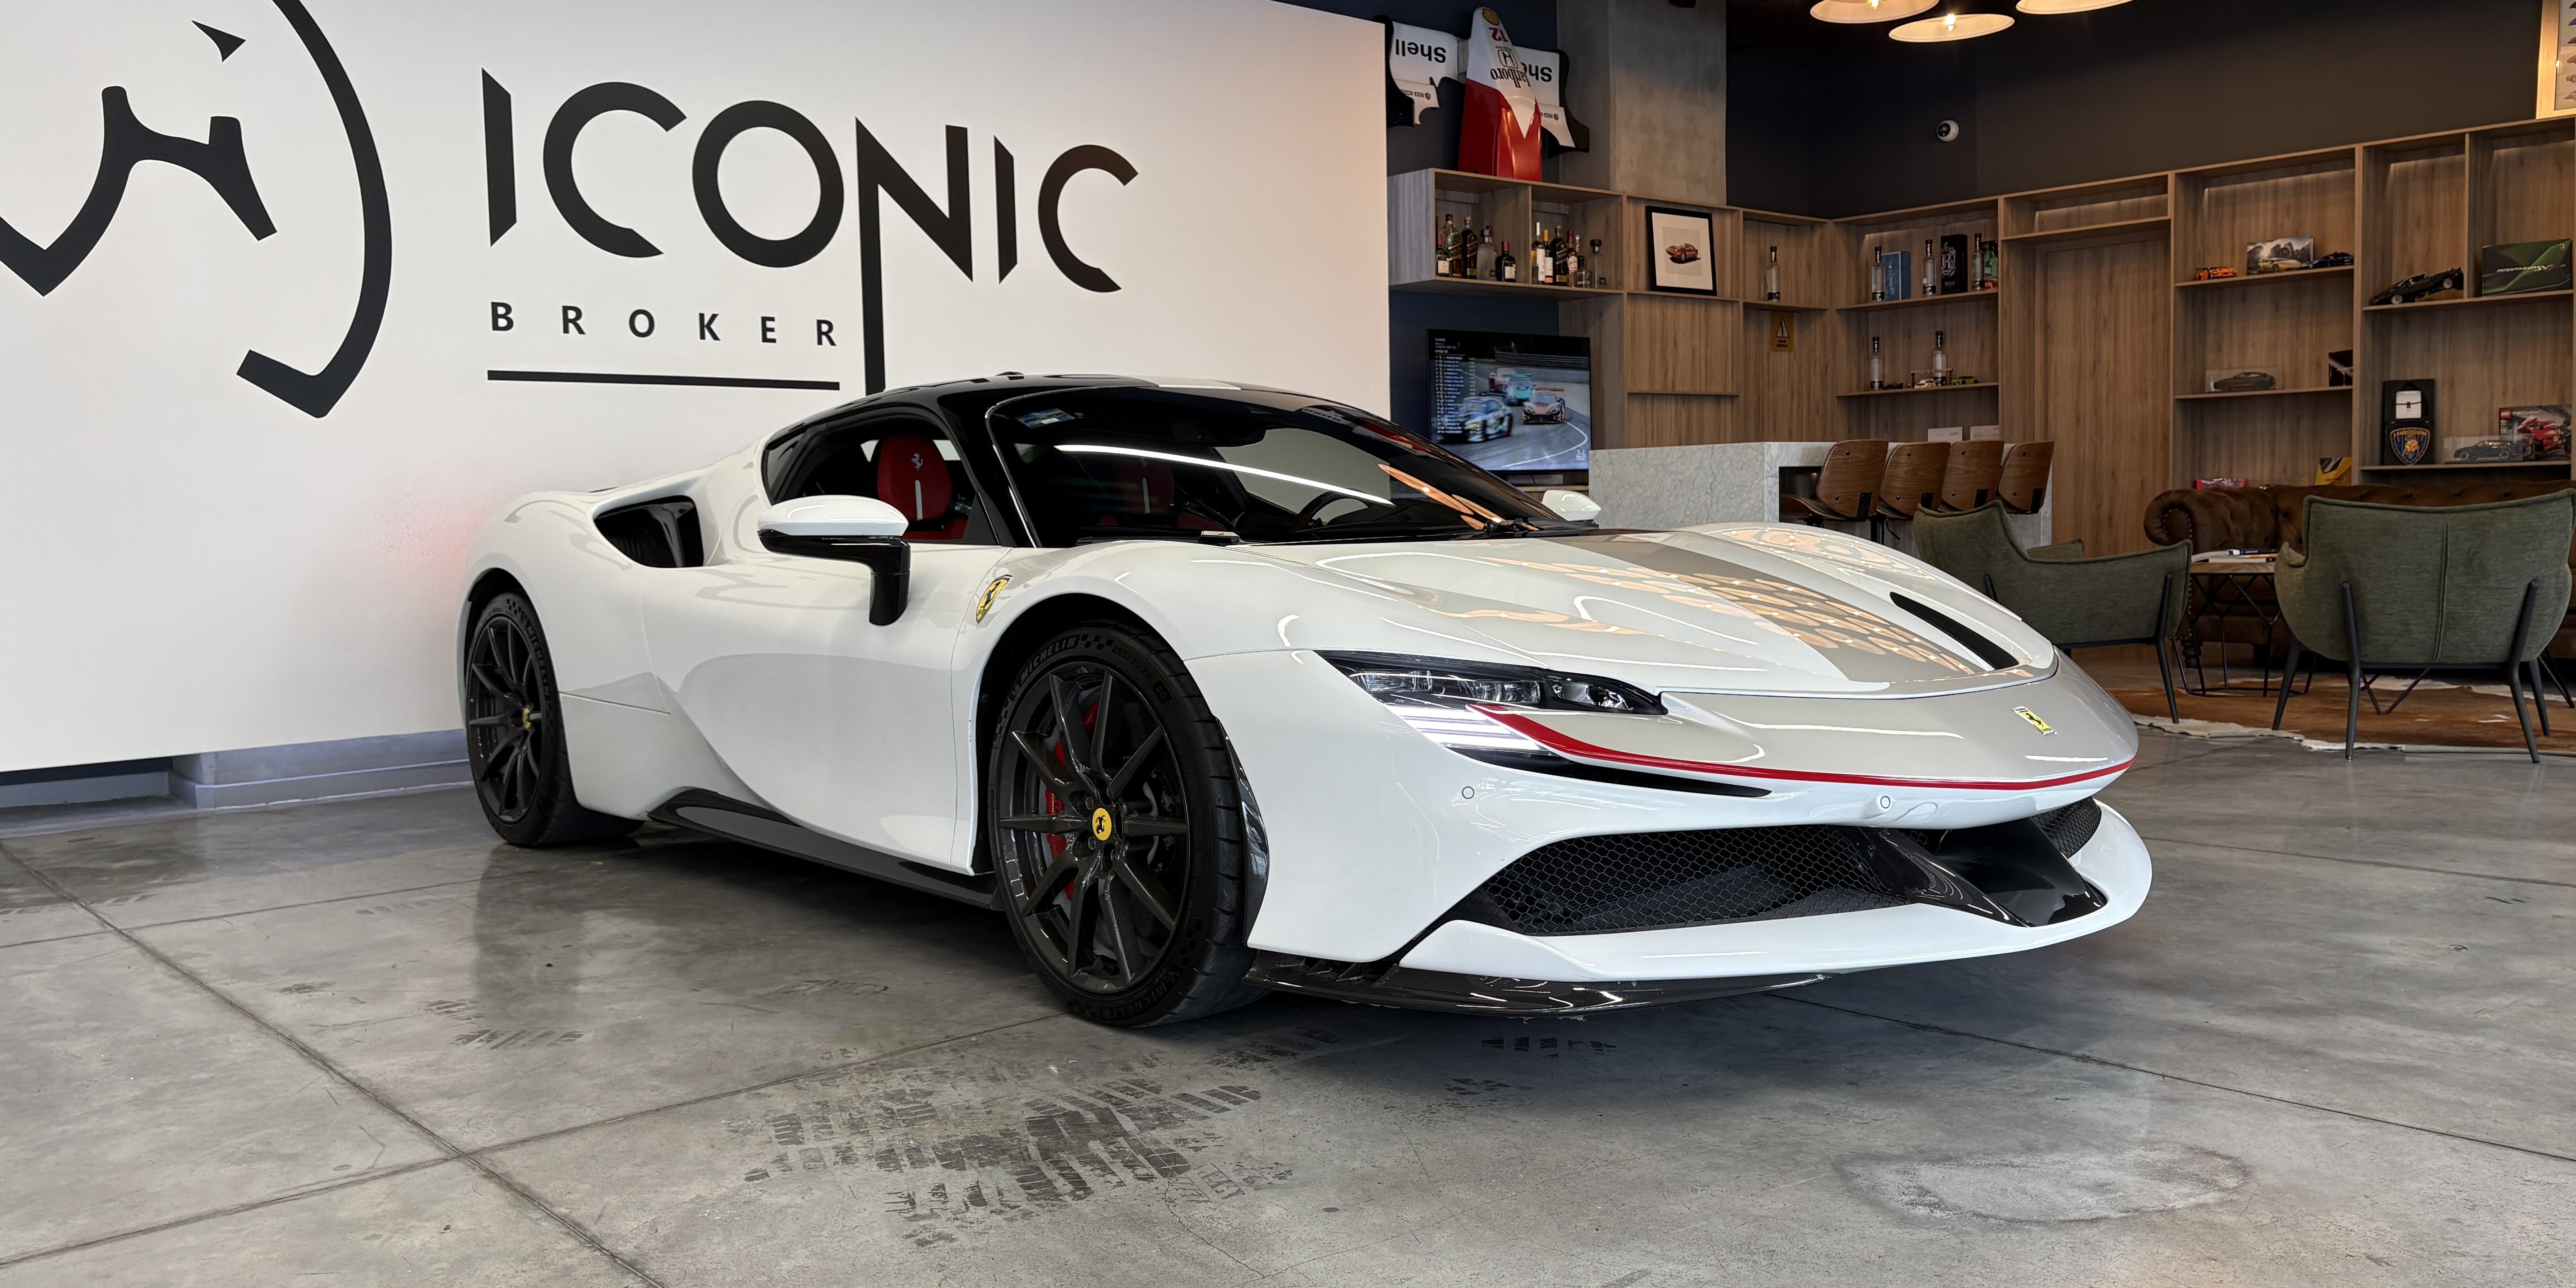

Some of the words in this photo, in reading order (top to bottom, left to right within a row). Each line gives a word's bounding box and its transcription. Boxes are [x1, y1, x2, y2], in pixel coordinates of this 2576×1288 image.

[1396, 39, 1446, 63] Shell
[1489, 28, 1509, 42] 12
[1521, 62, 1553, 82] She
[481, 67, 1139, 396] ICONIC
[490, 301, 837, 347] BROKER
[1021, 636, 1078, 684] MICHELIN
[1112, 645, 1142, 668] 255/35
[1155, 685, 1168, 699] 20
